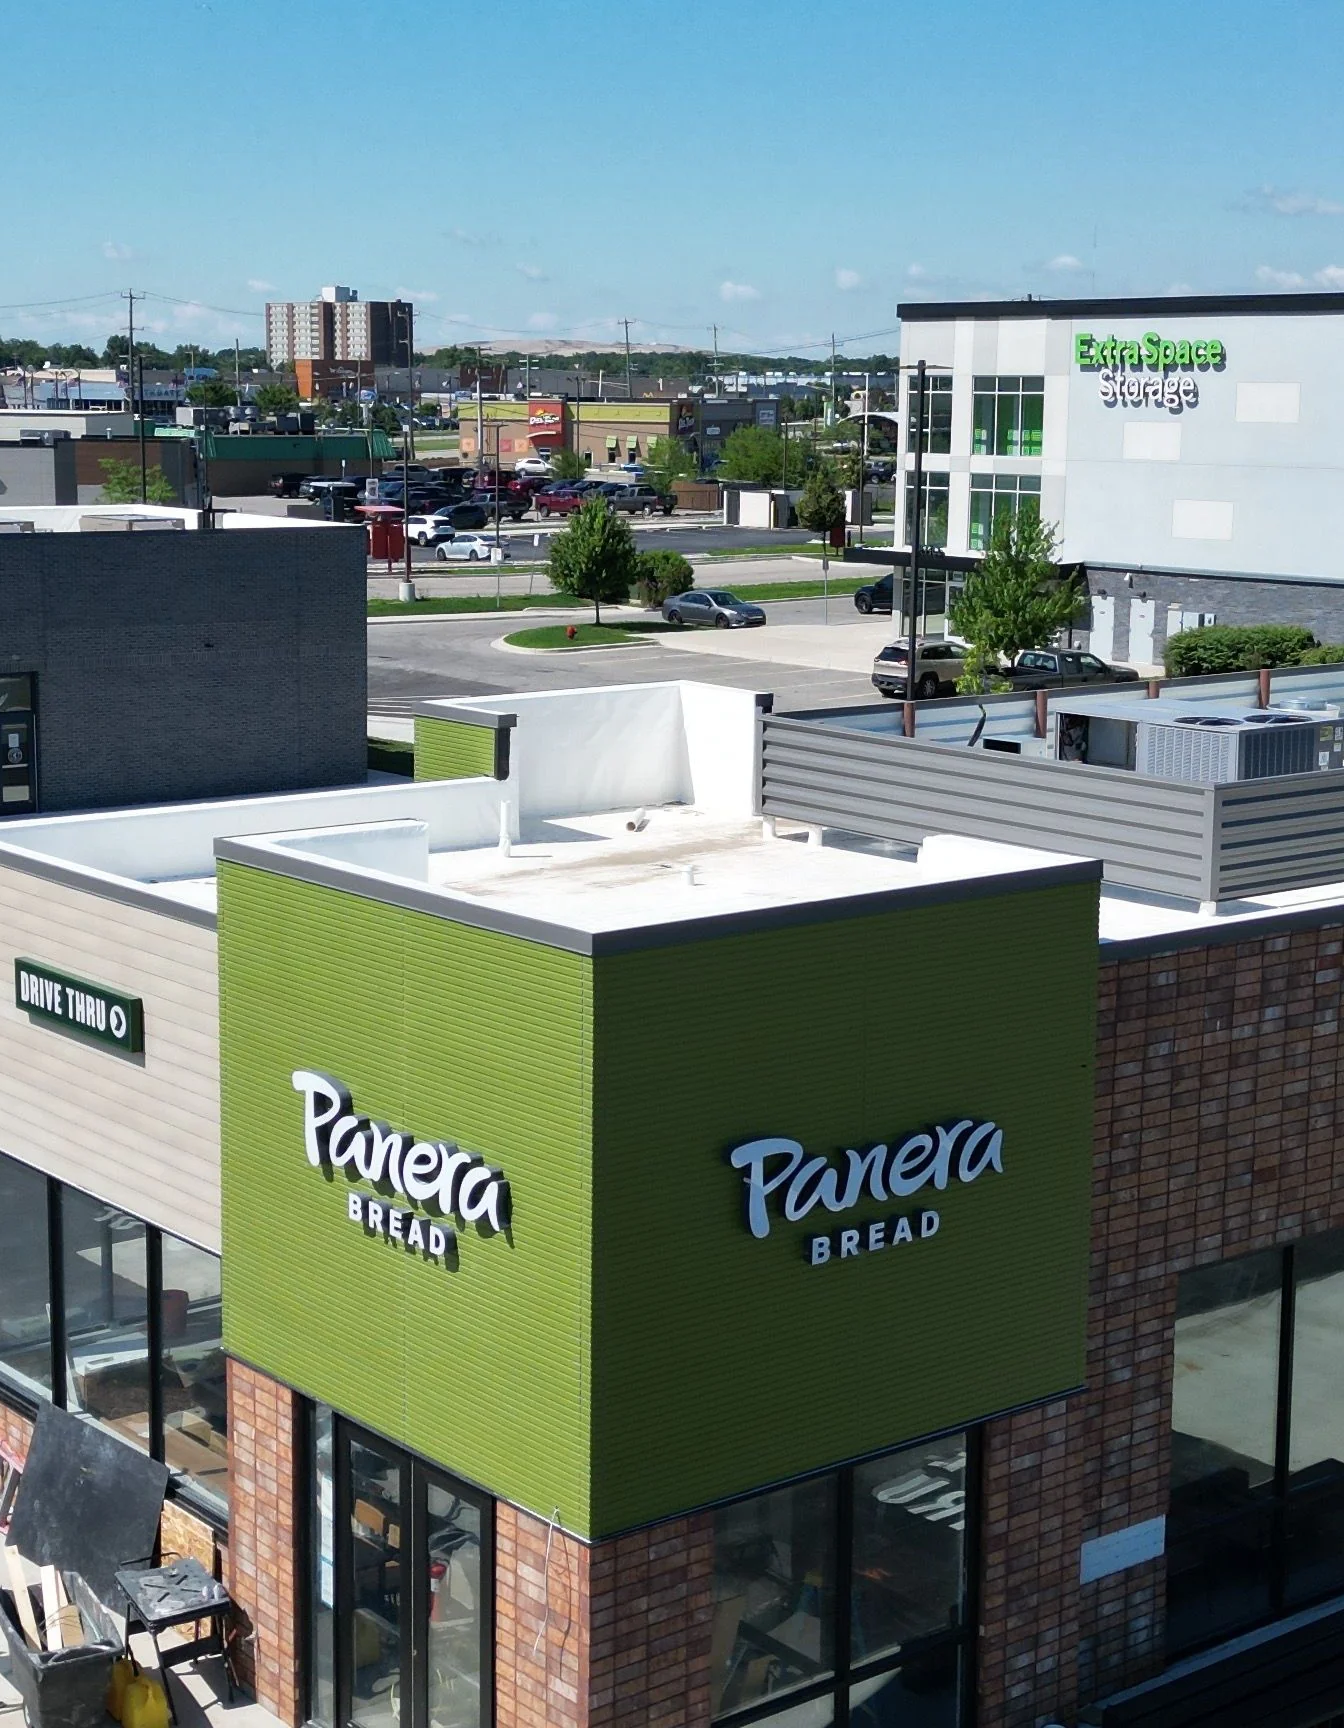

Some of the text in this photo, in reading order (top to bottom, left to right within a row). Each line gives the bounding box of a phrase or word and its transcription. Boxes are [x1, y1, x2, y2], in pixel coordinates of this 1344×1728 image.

[1097, 368, 1195, 408] Storage
[19, 970, 106, 1032] DRIVE THRU
[291, 1070, 504, 1233] Panera
[730, 1119, 1004, 1239] Panera
[348, 1191, 446, 1256] BREAD
[811, 1210, 941, 1266] BREAD
